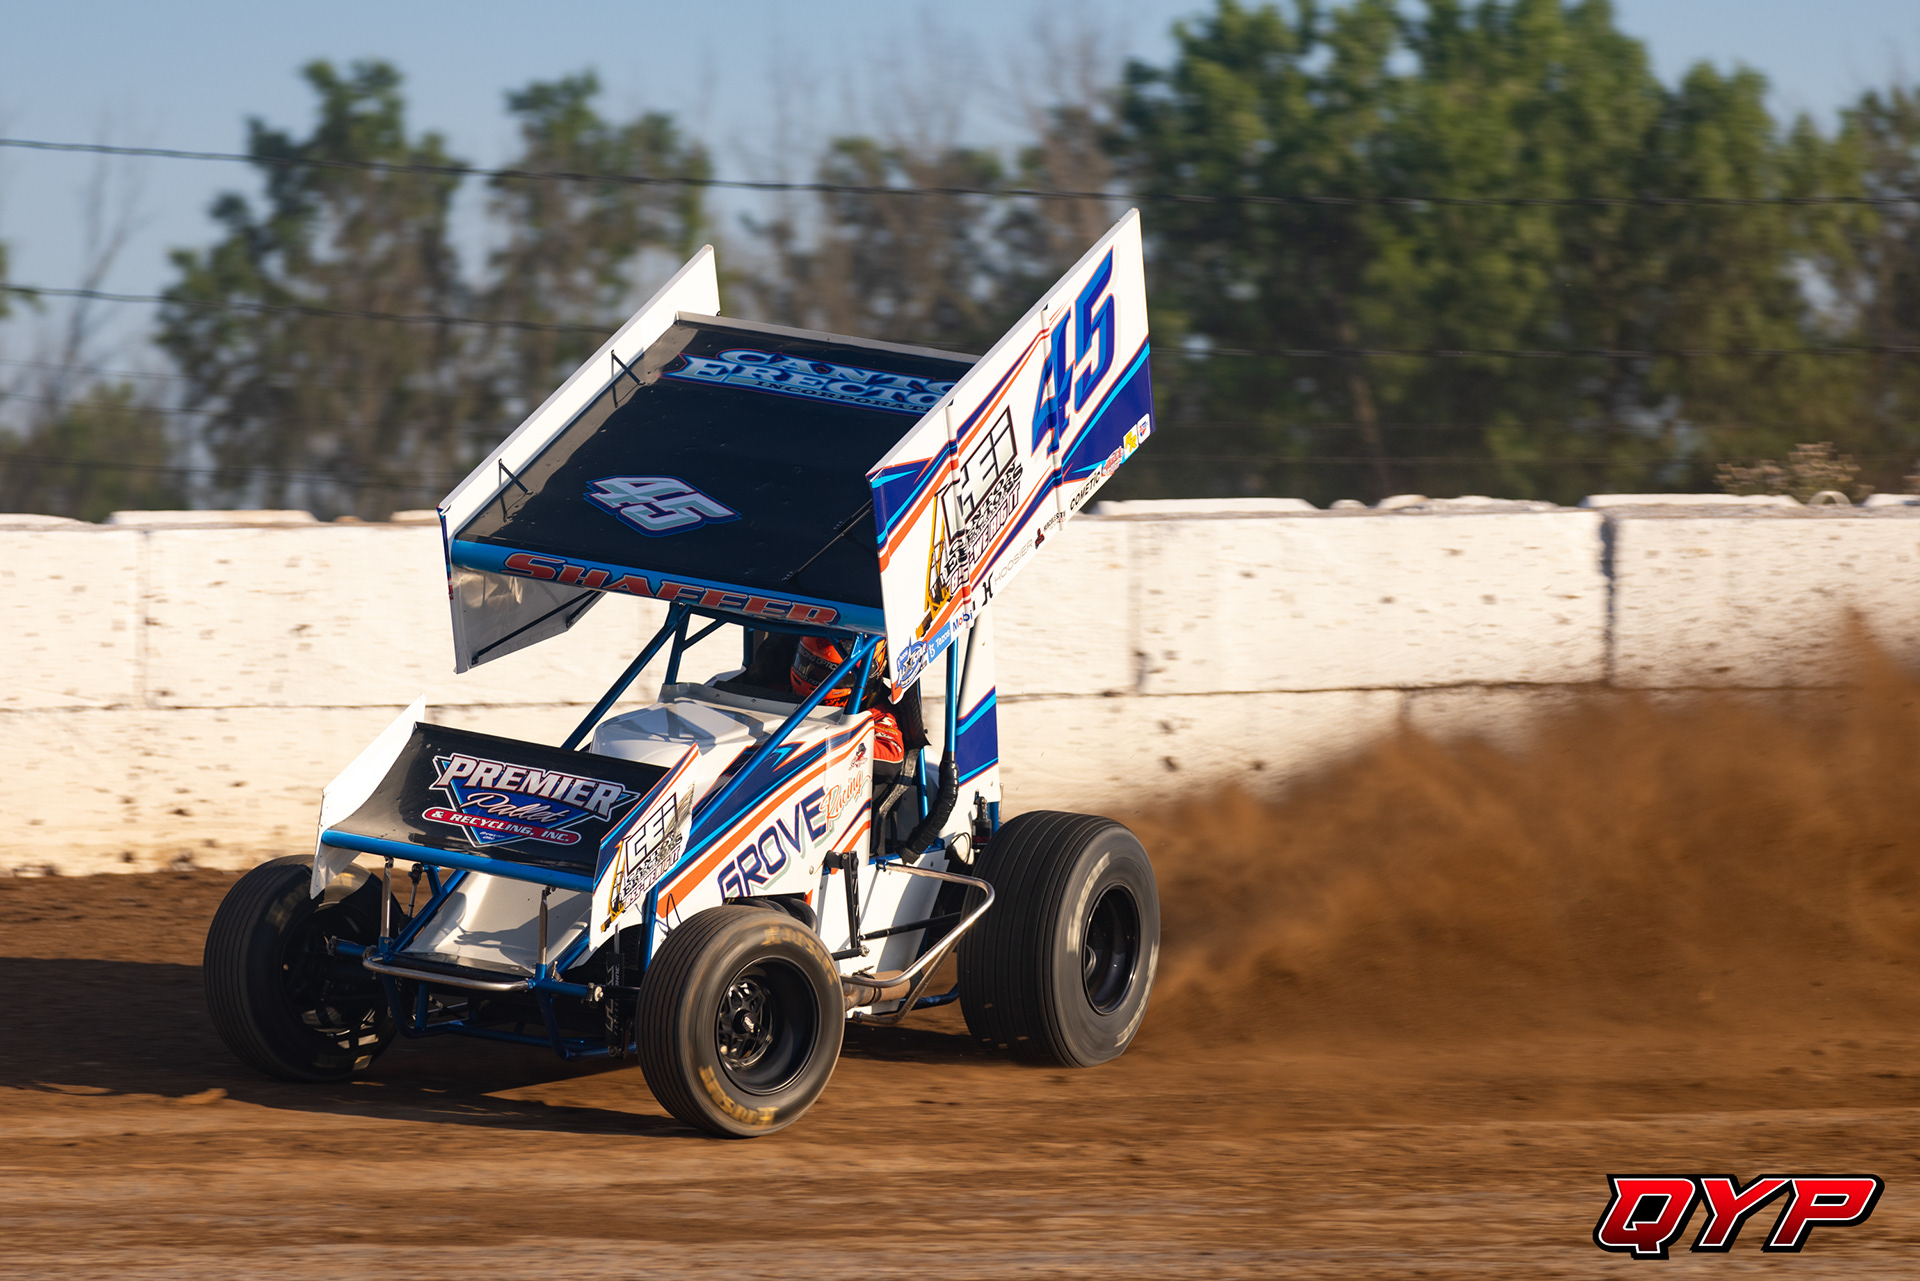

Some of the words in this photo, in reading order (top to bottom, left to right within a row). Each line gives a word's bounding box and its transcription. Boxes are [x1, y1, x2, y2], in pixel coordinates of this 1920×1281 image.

[717, 350, 958, 395] CANTO
[1031, 245, 1115, 459] 45
[673, 356, 943, 406] ERECTO
[755, 380, 931, 412] INCORPORAT
[586, 476, 739, 534] 45
[1070, 471, 1100, 510] COMETIC
[994, 539, 1032, 585] HOOSIER
[503, 552, 840, 626] SHAFFER
[816, 657, 839, 671] OPTIC
[436, 756, 624, 818] PREMIER
[460, 792, 570, 823] Pallet
[450, 813, 534, 836] RECYCLING,
[541, 831, 570, 842] INC.
[717, 786, 826, 899] GROVE
[820, 771, 871, 831] Racing
